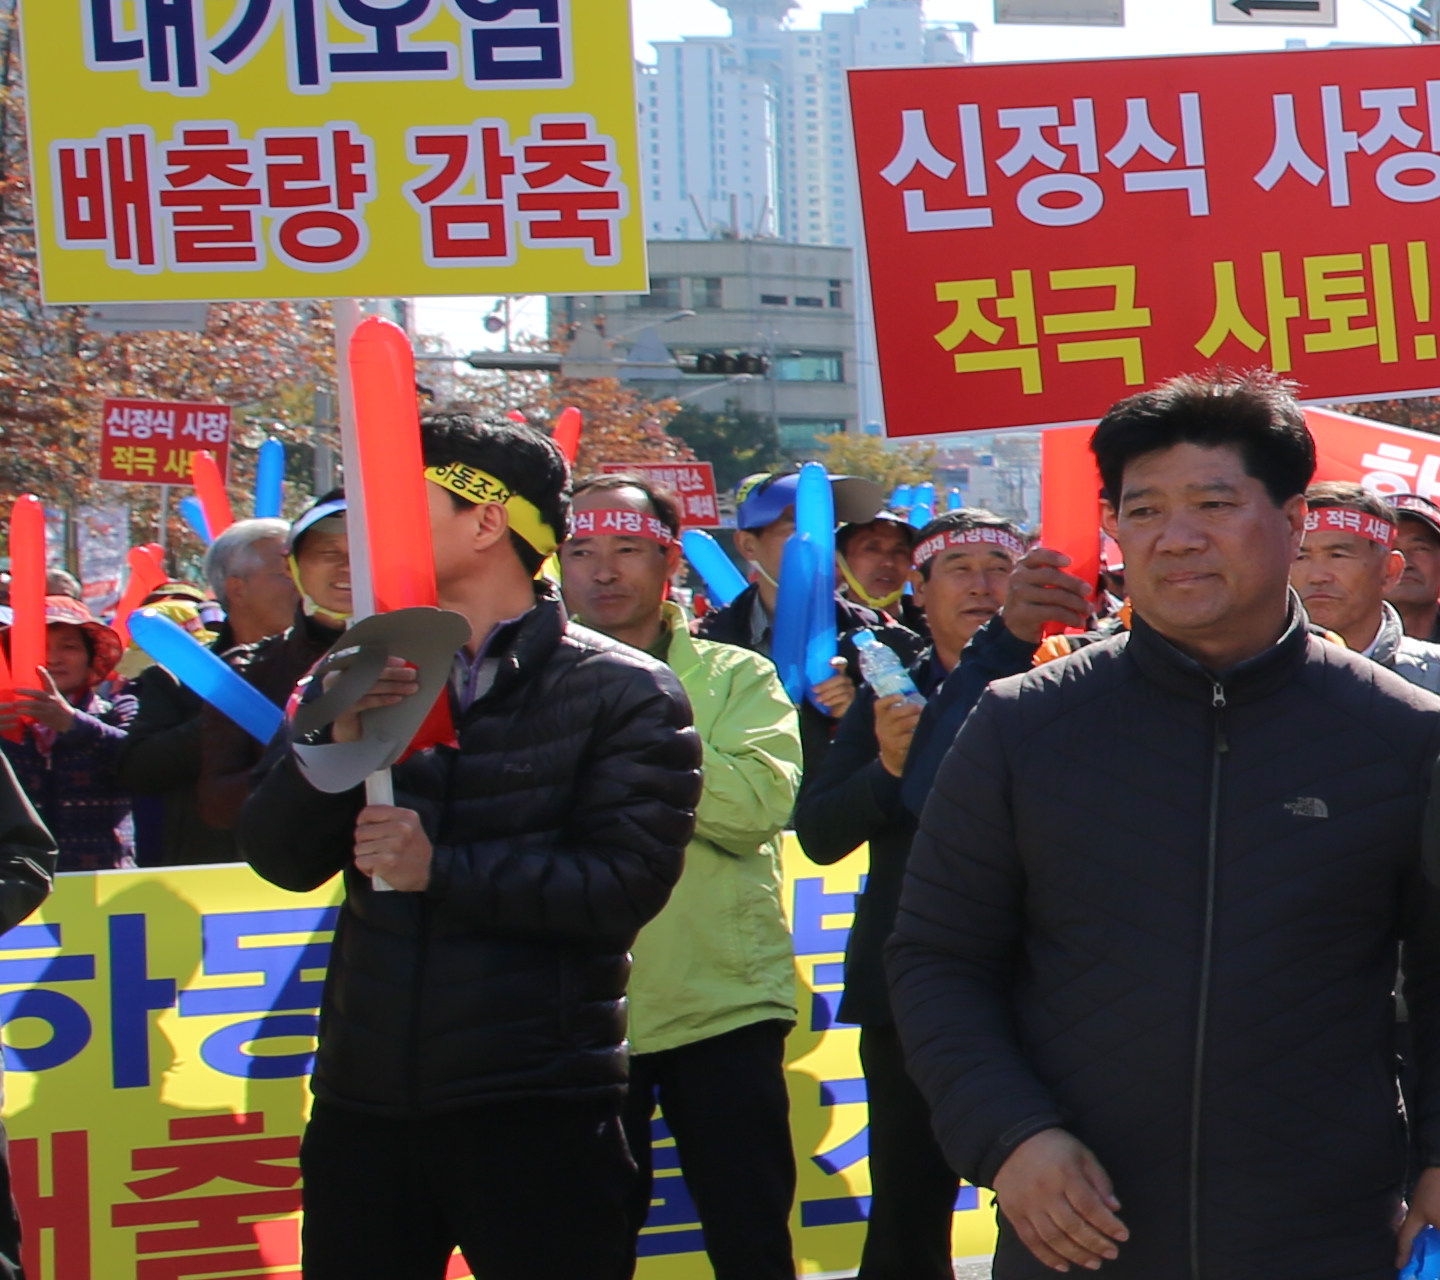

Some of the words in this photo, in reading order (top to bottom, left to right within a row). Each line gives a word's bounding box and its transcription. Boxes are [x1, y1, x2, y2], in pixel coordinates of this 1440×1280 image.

[880, 92, 1209, 233] 신정식
[57, 128, 367, 266] 배출량
[413, 122, 621, 260] 감축
[933, 263, 1151, 396] 적극
[1194, 240, 1438, 374] 사퇴!
[105, 406, 176, 440] 신정식
[181, 410, 229, 444] 사장
[111, 445, 157, 477] 적극
[601, 510, 643, 533] 사장
[1325, 508, 1362, 533] 적극
[1364, 521, 1393, 545] 사퇴
